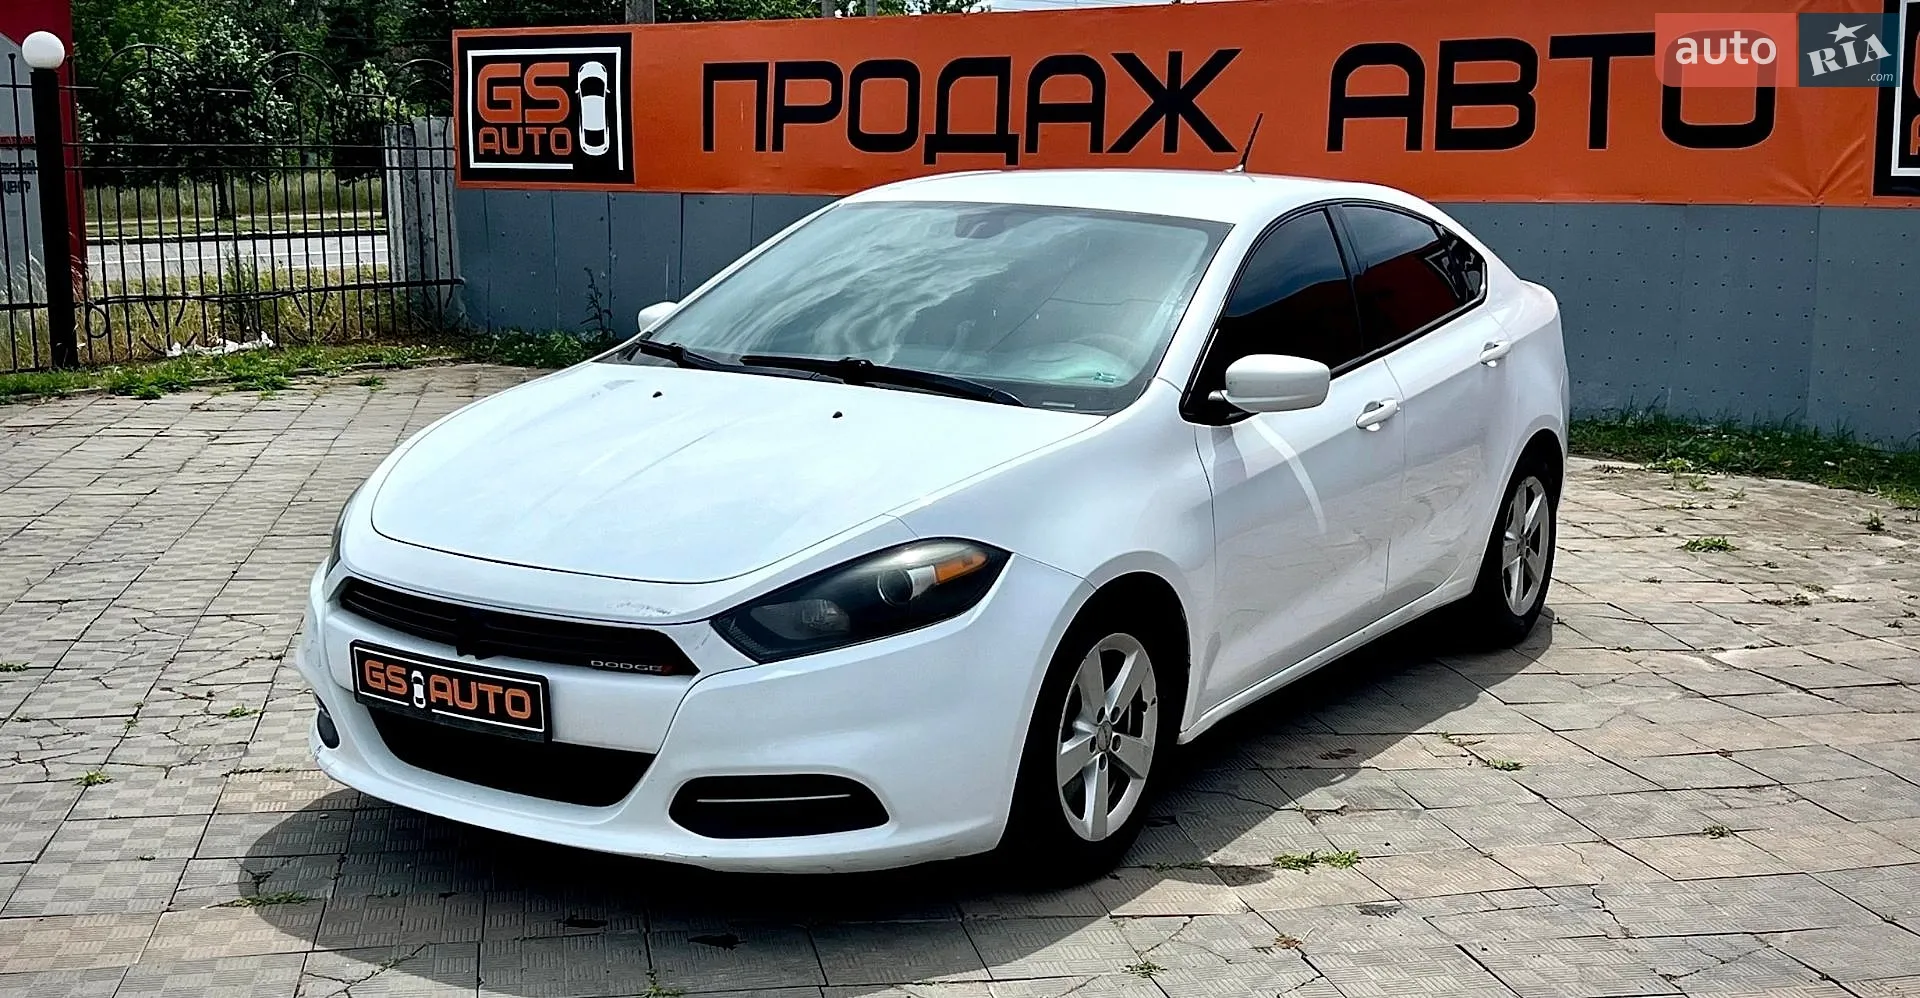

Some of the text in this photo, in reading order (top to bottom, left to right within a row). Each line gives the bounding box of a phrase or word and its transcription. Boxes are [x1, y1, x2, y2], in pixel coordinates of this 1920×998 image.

[477, 61, 570, 124] GS
[702, 48, 1242, 165] ПРОДАЖ
[1327, 29, 1777, 150] АВТО
[478, 126, 572, 156] AUTO
[363, 658, 532, 719] GS AUTO
[590, 659, 664, 672] DODGE
